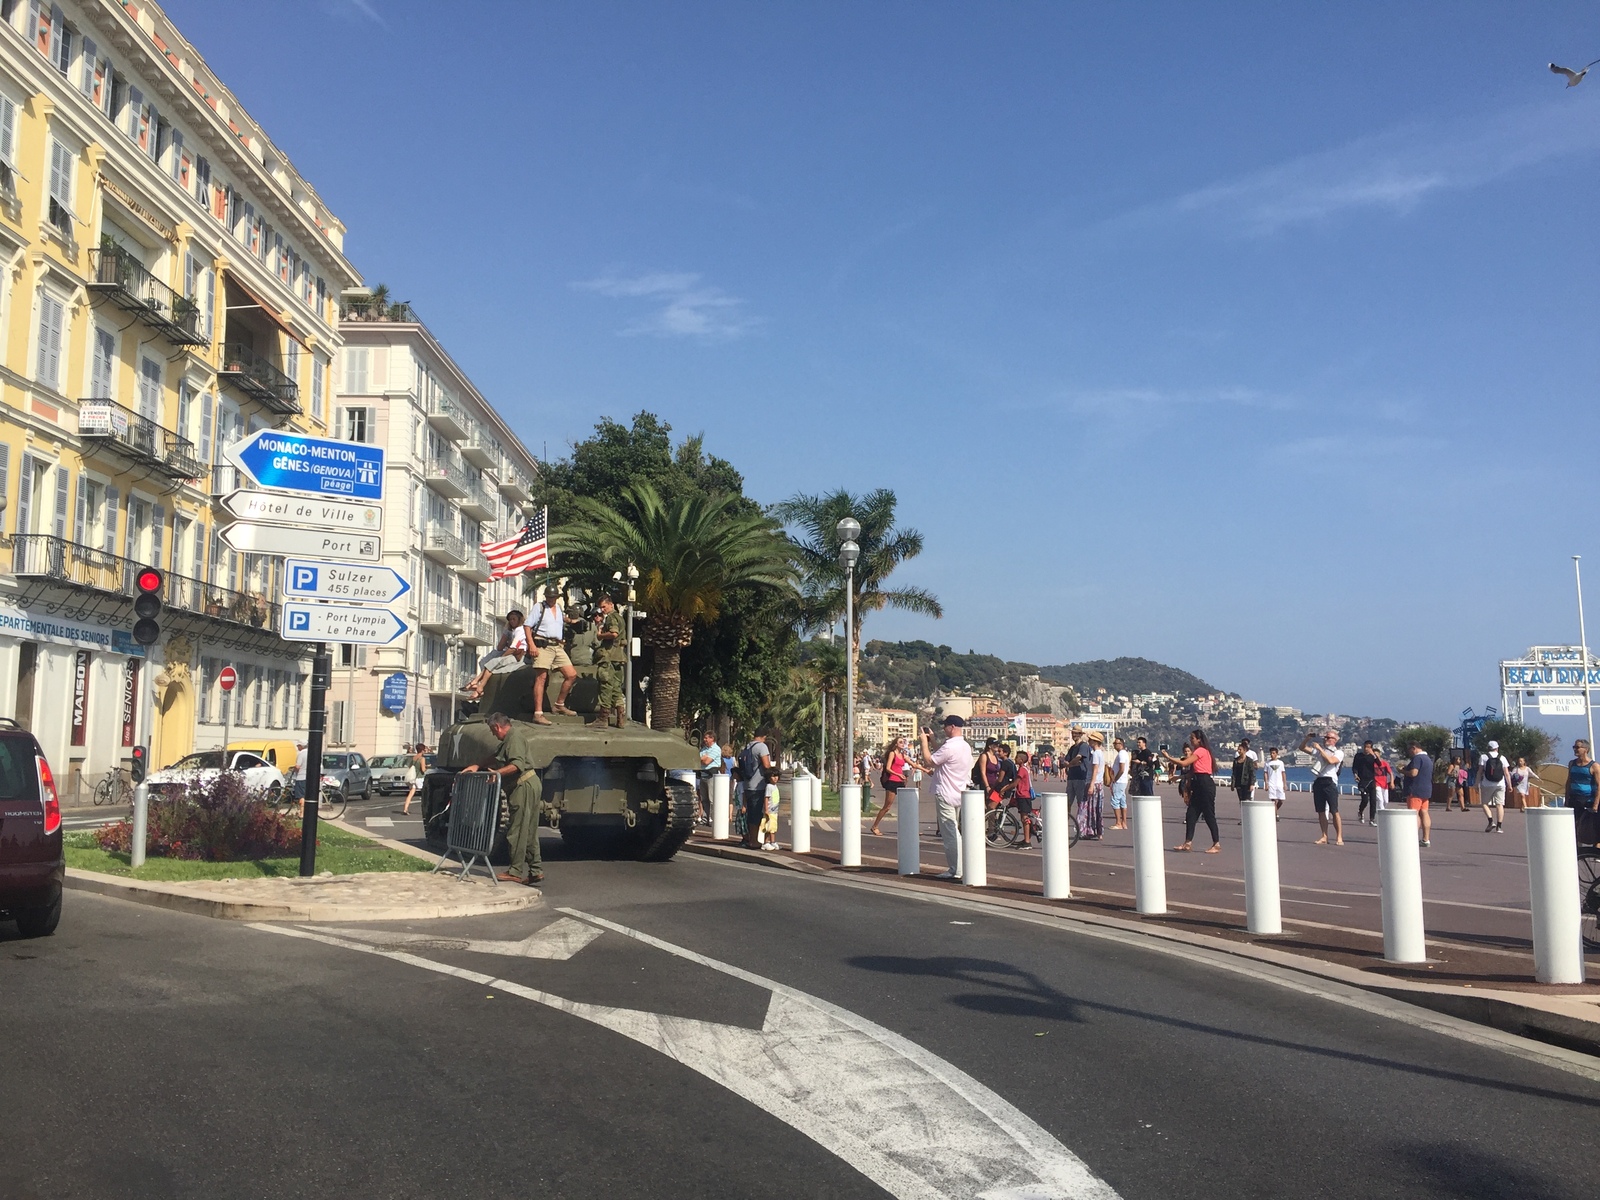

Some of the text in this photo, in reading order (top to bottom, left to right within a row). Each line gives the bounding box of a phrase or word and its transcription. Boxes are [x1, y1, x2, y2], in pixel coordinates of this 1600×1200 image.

[258, 438, 356, 462] MONACO-MENTON
[272, 456, 355, 479] GÊNES (GENOVA)
[323, 480, 351, 491] péage
[248, 499, 355, 522] Hôtel de Ville
[321, 538, 352, 552] Port
[297, 569, 313, 588] P
[328, 569, 374, 584] Sulzer
[327, 583, 388, 597] 455 places
[293, 613, 307, 629] P
[326, 612, 349, 623] Port
[352, 614, 387, 626] Lympia
[65, 627, 80, 639] DES
[81, 630, 110, 645] SENIORS
[327, 625, 340, 635] Le
[345, 626, 377, 637] Phare
[1509, 667, 1553, 684] BEAU
[74, 652, 87, 726] MAISON
[123, 660, 134, 723] SENIORS
